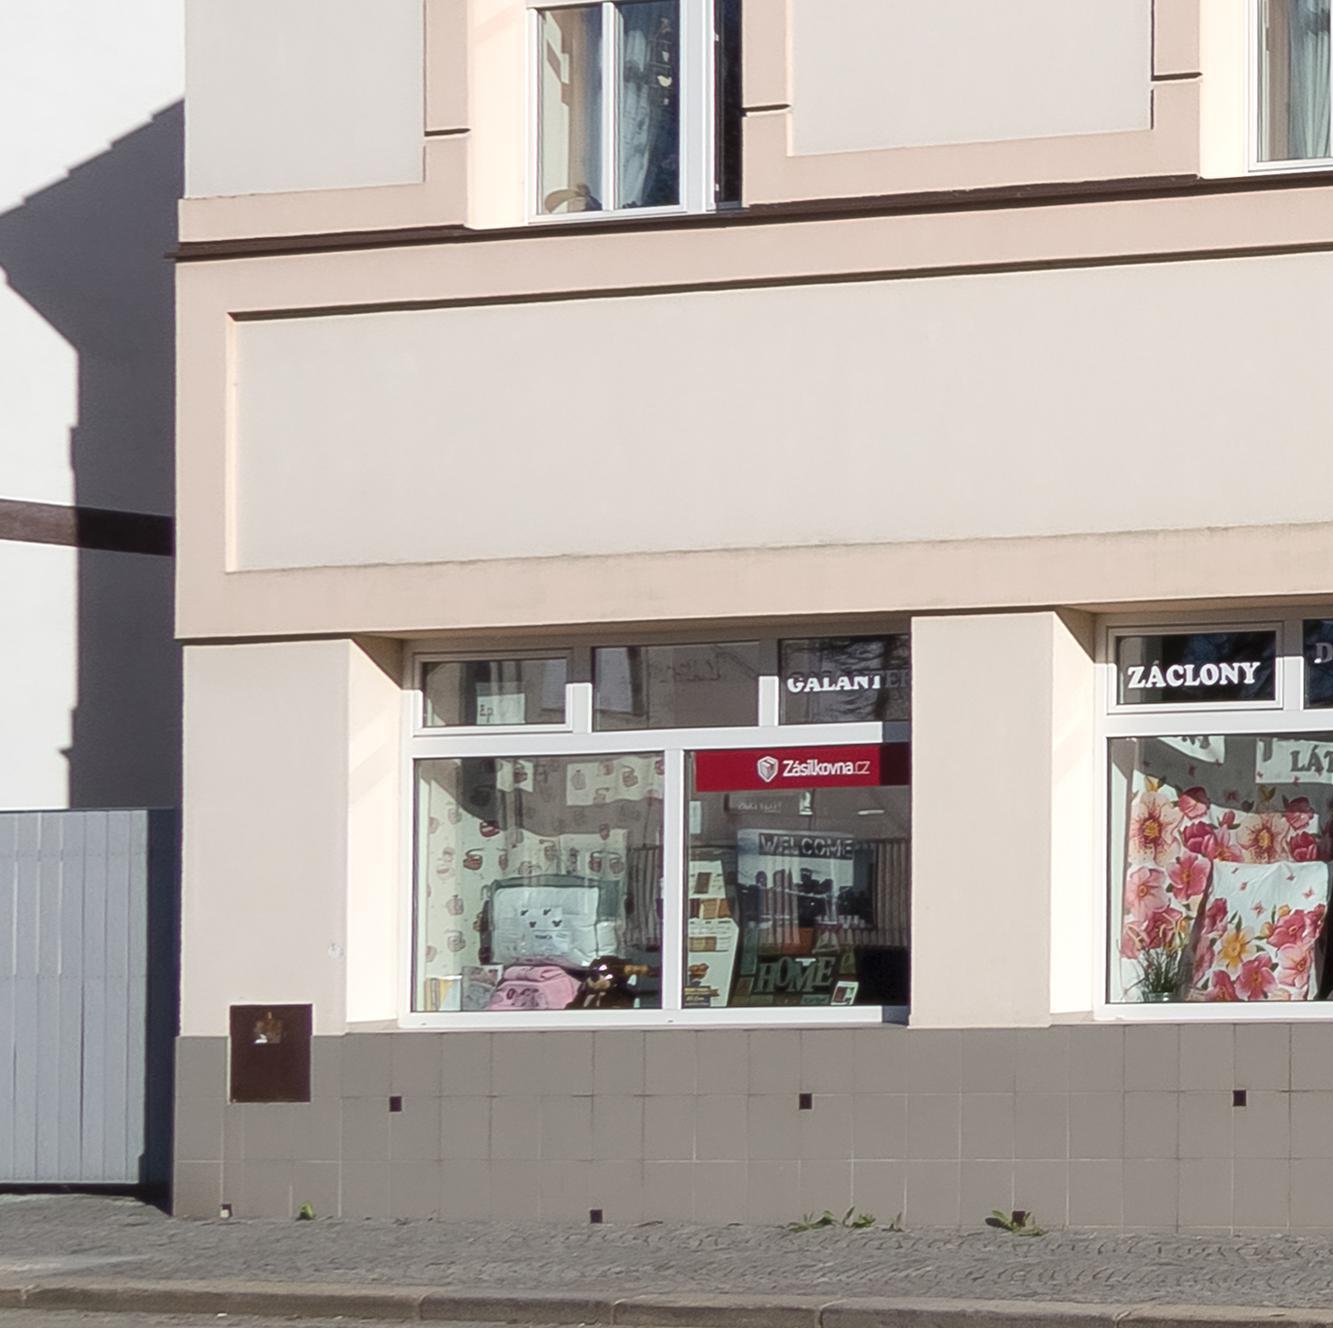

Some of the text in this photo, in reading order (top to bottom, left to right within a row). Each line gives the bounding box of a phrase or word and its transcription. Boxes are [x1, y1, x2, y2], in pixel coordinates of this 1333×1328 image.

[1127, 658, 1262, 689] ZÁCLONY
[761, 834, 854, 858] WELCOME
[754, 956, 836, 992] HOME
